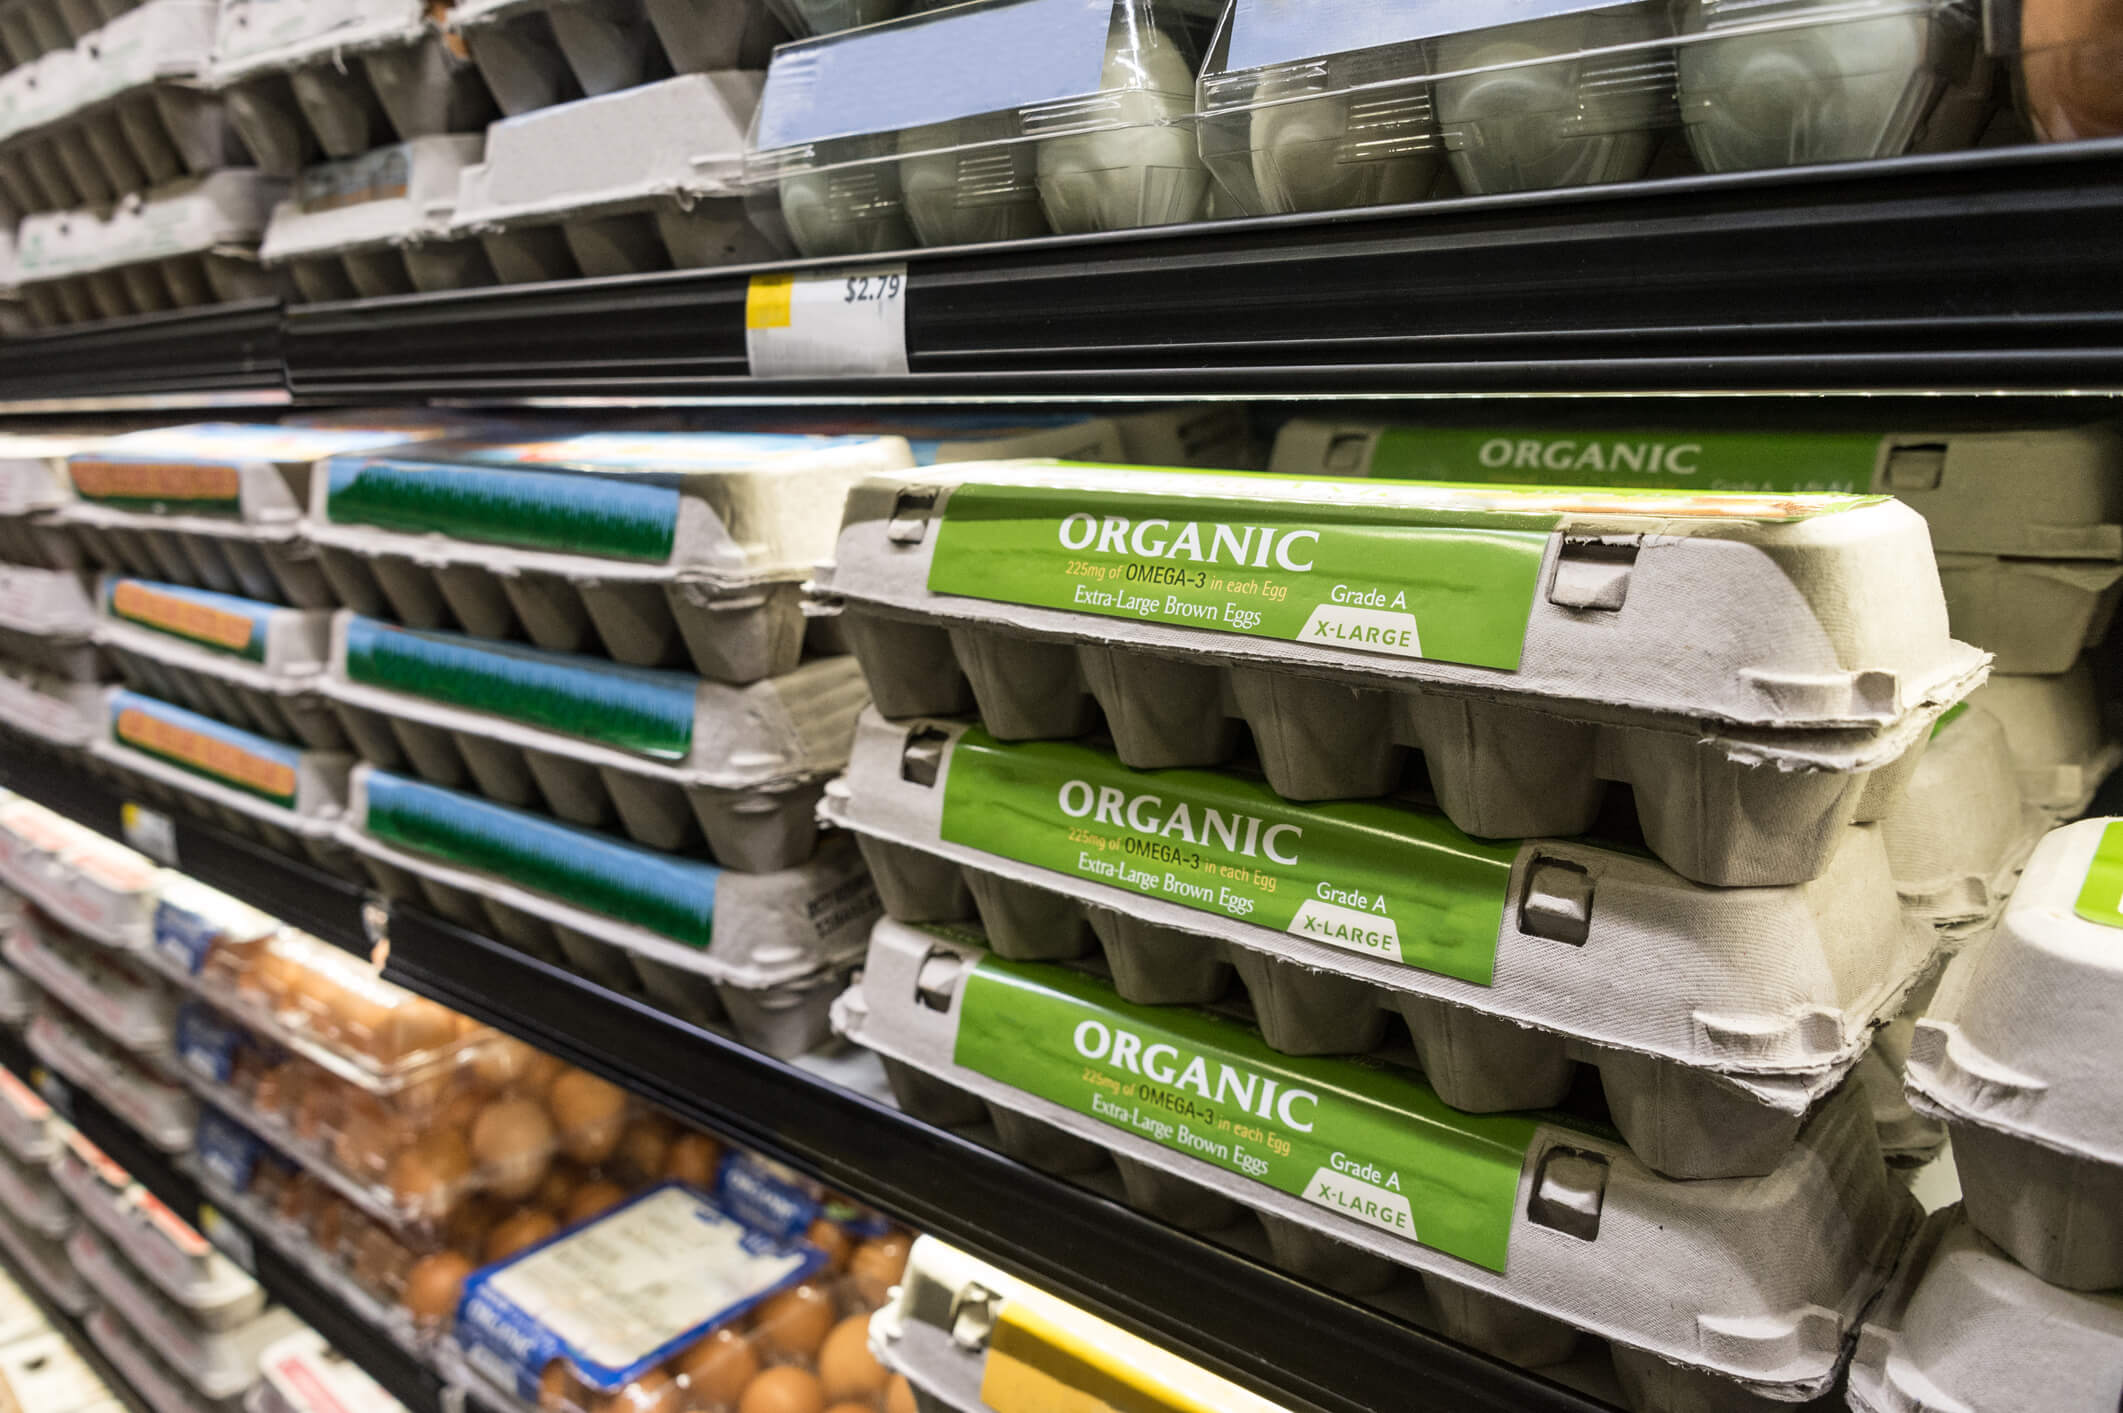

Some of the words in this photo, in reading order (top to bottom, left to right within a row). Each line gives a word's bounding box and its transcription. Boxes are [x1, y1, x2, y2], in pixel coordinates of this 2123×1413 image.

[845, 274, 901, 303] $2.79
[1478, 437, 1701, 475] ORGANIC
[1058, 512, 1320, 572] ORGANIC
[1065, 560, 1106, 581] 225mg
[1109, 564, 1124, 580] of
[1126, 563, 1206, 589] OMEGA-3
[1210, 575, 1224, 591] in
[1226, 578, 1258, 597] each
[1261, 580, 1288, 602] Egg
[1331, 584, 1387, 607] Grade
[1390, 590, 1407, 610] A
[1074, 584, 1160, 616] Extra-Large
[1164, 595, 1218, 621] Brown
[1223, 602, 1262, 629] Eggs
[1314, 620, 1412, 647] X-LARGE
[1058, 780, 1304, 866] ORGANIC
[1068, 826, 1106, 851] 225mg
[1108, 836, 1121, 850] of
[1125, 837, 1200, 869] OMEGA-3
[1204, 858, 1217, 875] in
[1219, 864, 1249, 882] each
[1253, 869, 1277, 893] Egg
[1078, 851, 1159, 890] Extra-Large
[1163, 872, 1214, 903] Brown
[1219, 885, 1255, 915] Eggs
[1316, 881, 1368, 909] Grade
[1372, 895, 1387, 914] A
[1303, 914, 1393, 951] X-LARGE
[1073, 1020, 1319, 1133] ORGANIC
[1092, 1092, 1174, 1139] Extra-Large
[1177, 1123, 1228, 1160] Brown
[1232, 1144, 1269, 1176] Eggs
[1138, 1084, 1214, 1125] OMEGA-3
[1217, 1114, 1231, 1131] in
[1233, 1123, 1264, 1144] each
[1266, 1130, 1291, 1157] Egg
[1330, 1150, 1381, 1185] Grade
[1385, 1170, 1401, 1192] A
[1317, 1182, 1407, 1229] X-LARGE
